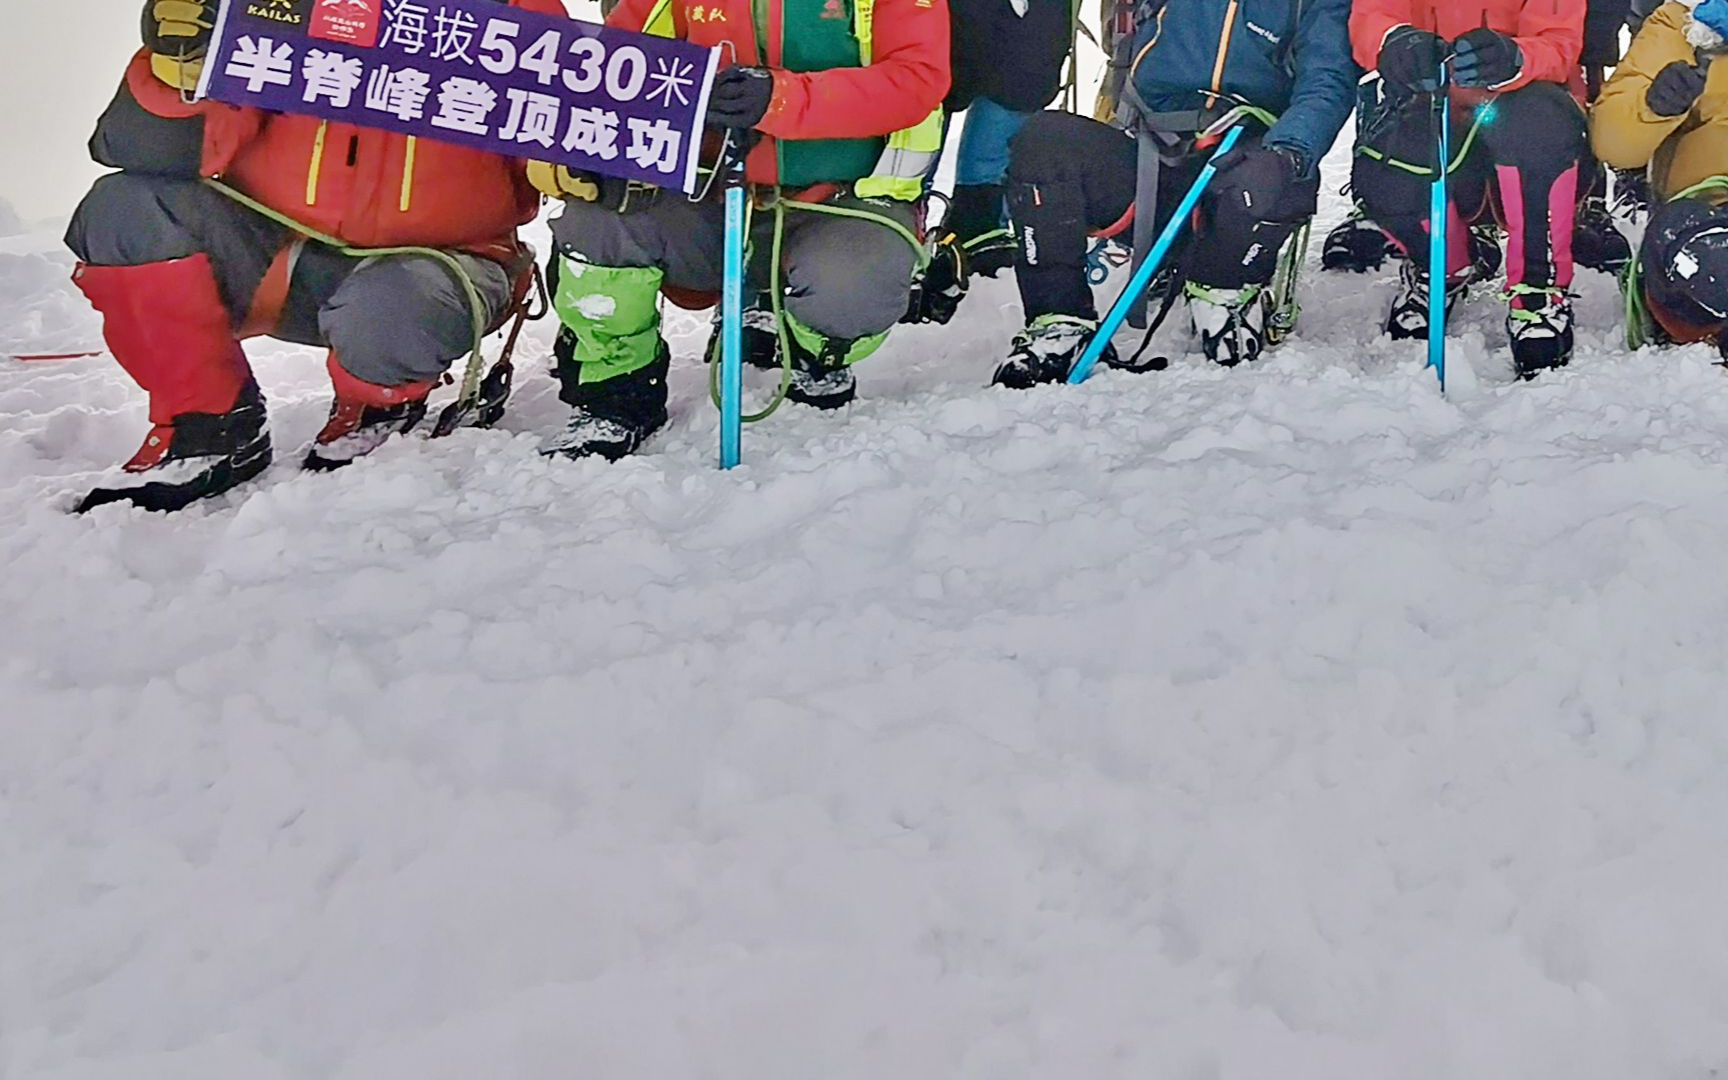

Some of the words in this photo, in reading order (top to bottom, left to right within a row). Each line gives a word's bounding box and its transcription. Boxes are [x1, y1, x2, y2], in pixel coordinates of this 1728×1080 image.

[246, 3, 302, 25] KAILAS
[224, 35, 683, 174] 半脊峰登顶成功
